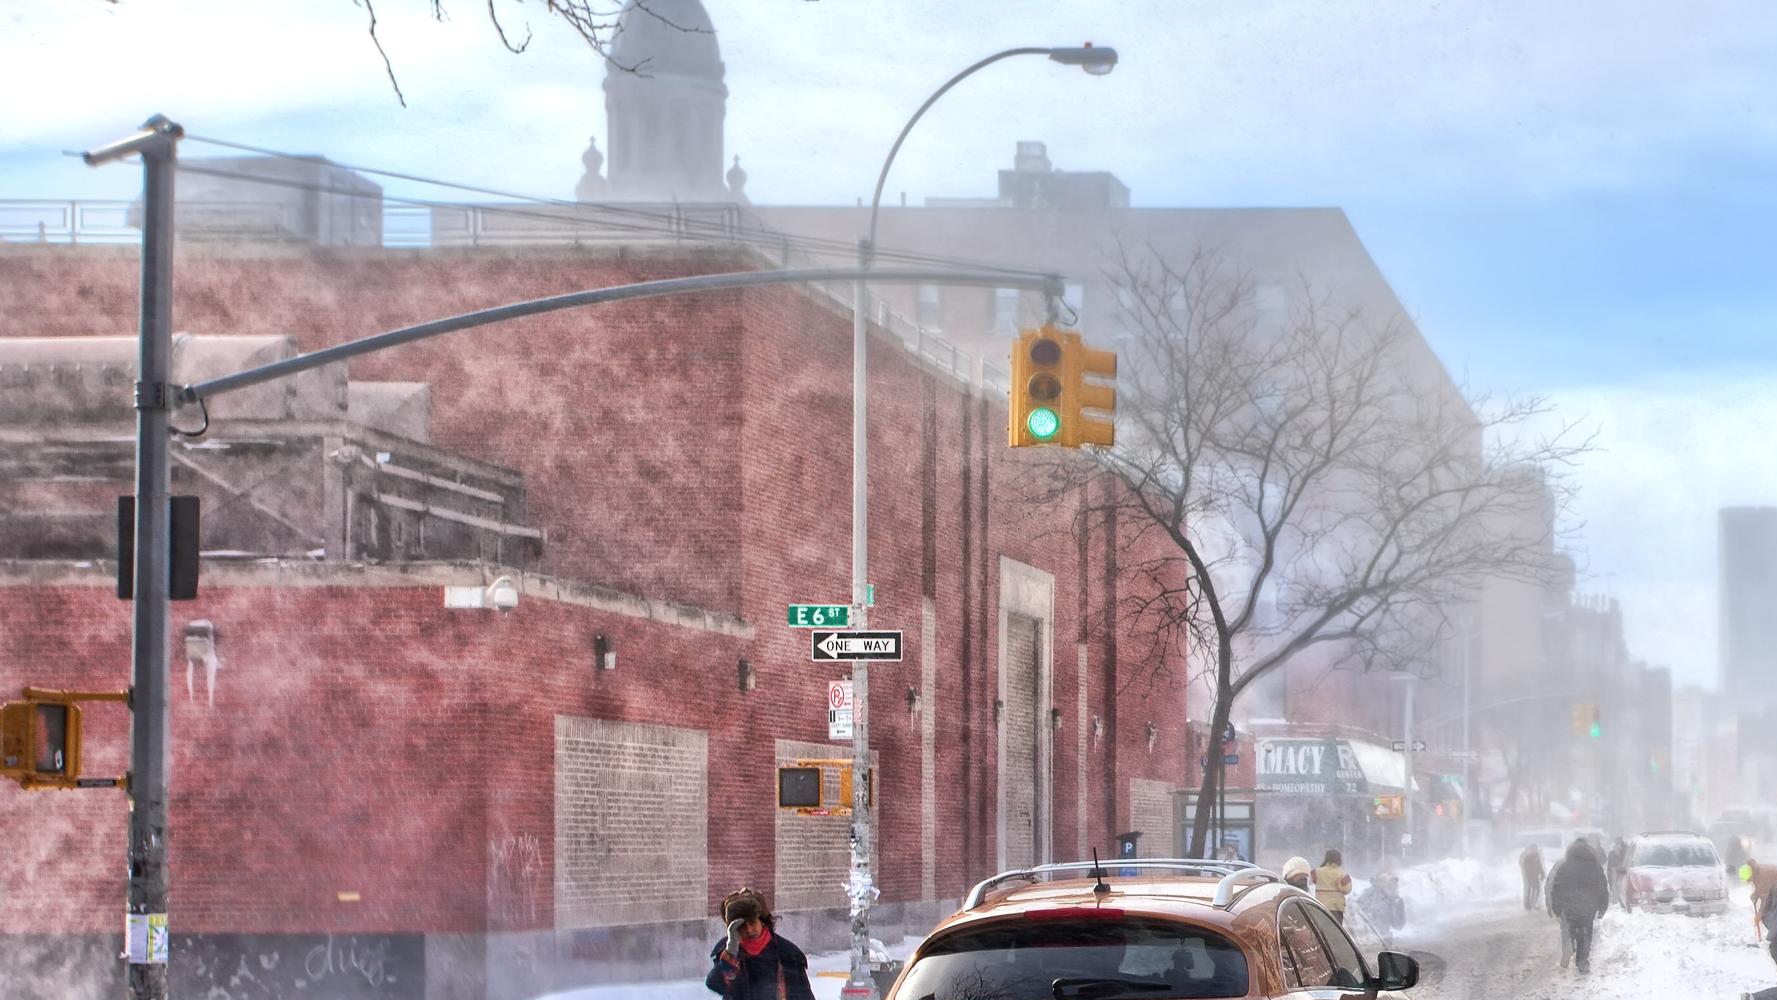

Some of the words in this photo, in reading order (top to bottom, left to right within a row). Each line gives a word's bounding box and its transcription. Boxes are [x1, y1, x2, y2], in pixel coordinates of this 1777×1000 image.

[797, 607, 809, 624] E
[813, 607, 825, 624] 6
[828, 607, 841, 617] ST
[826, 641, 851, 651] ONE
[863, 640, 890, 651] WAY
[1125, 842, 1133, 853] P
